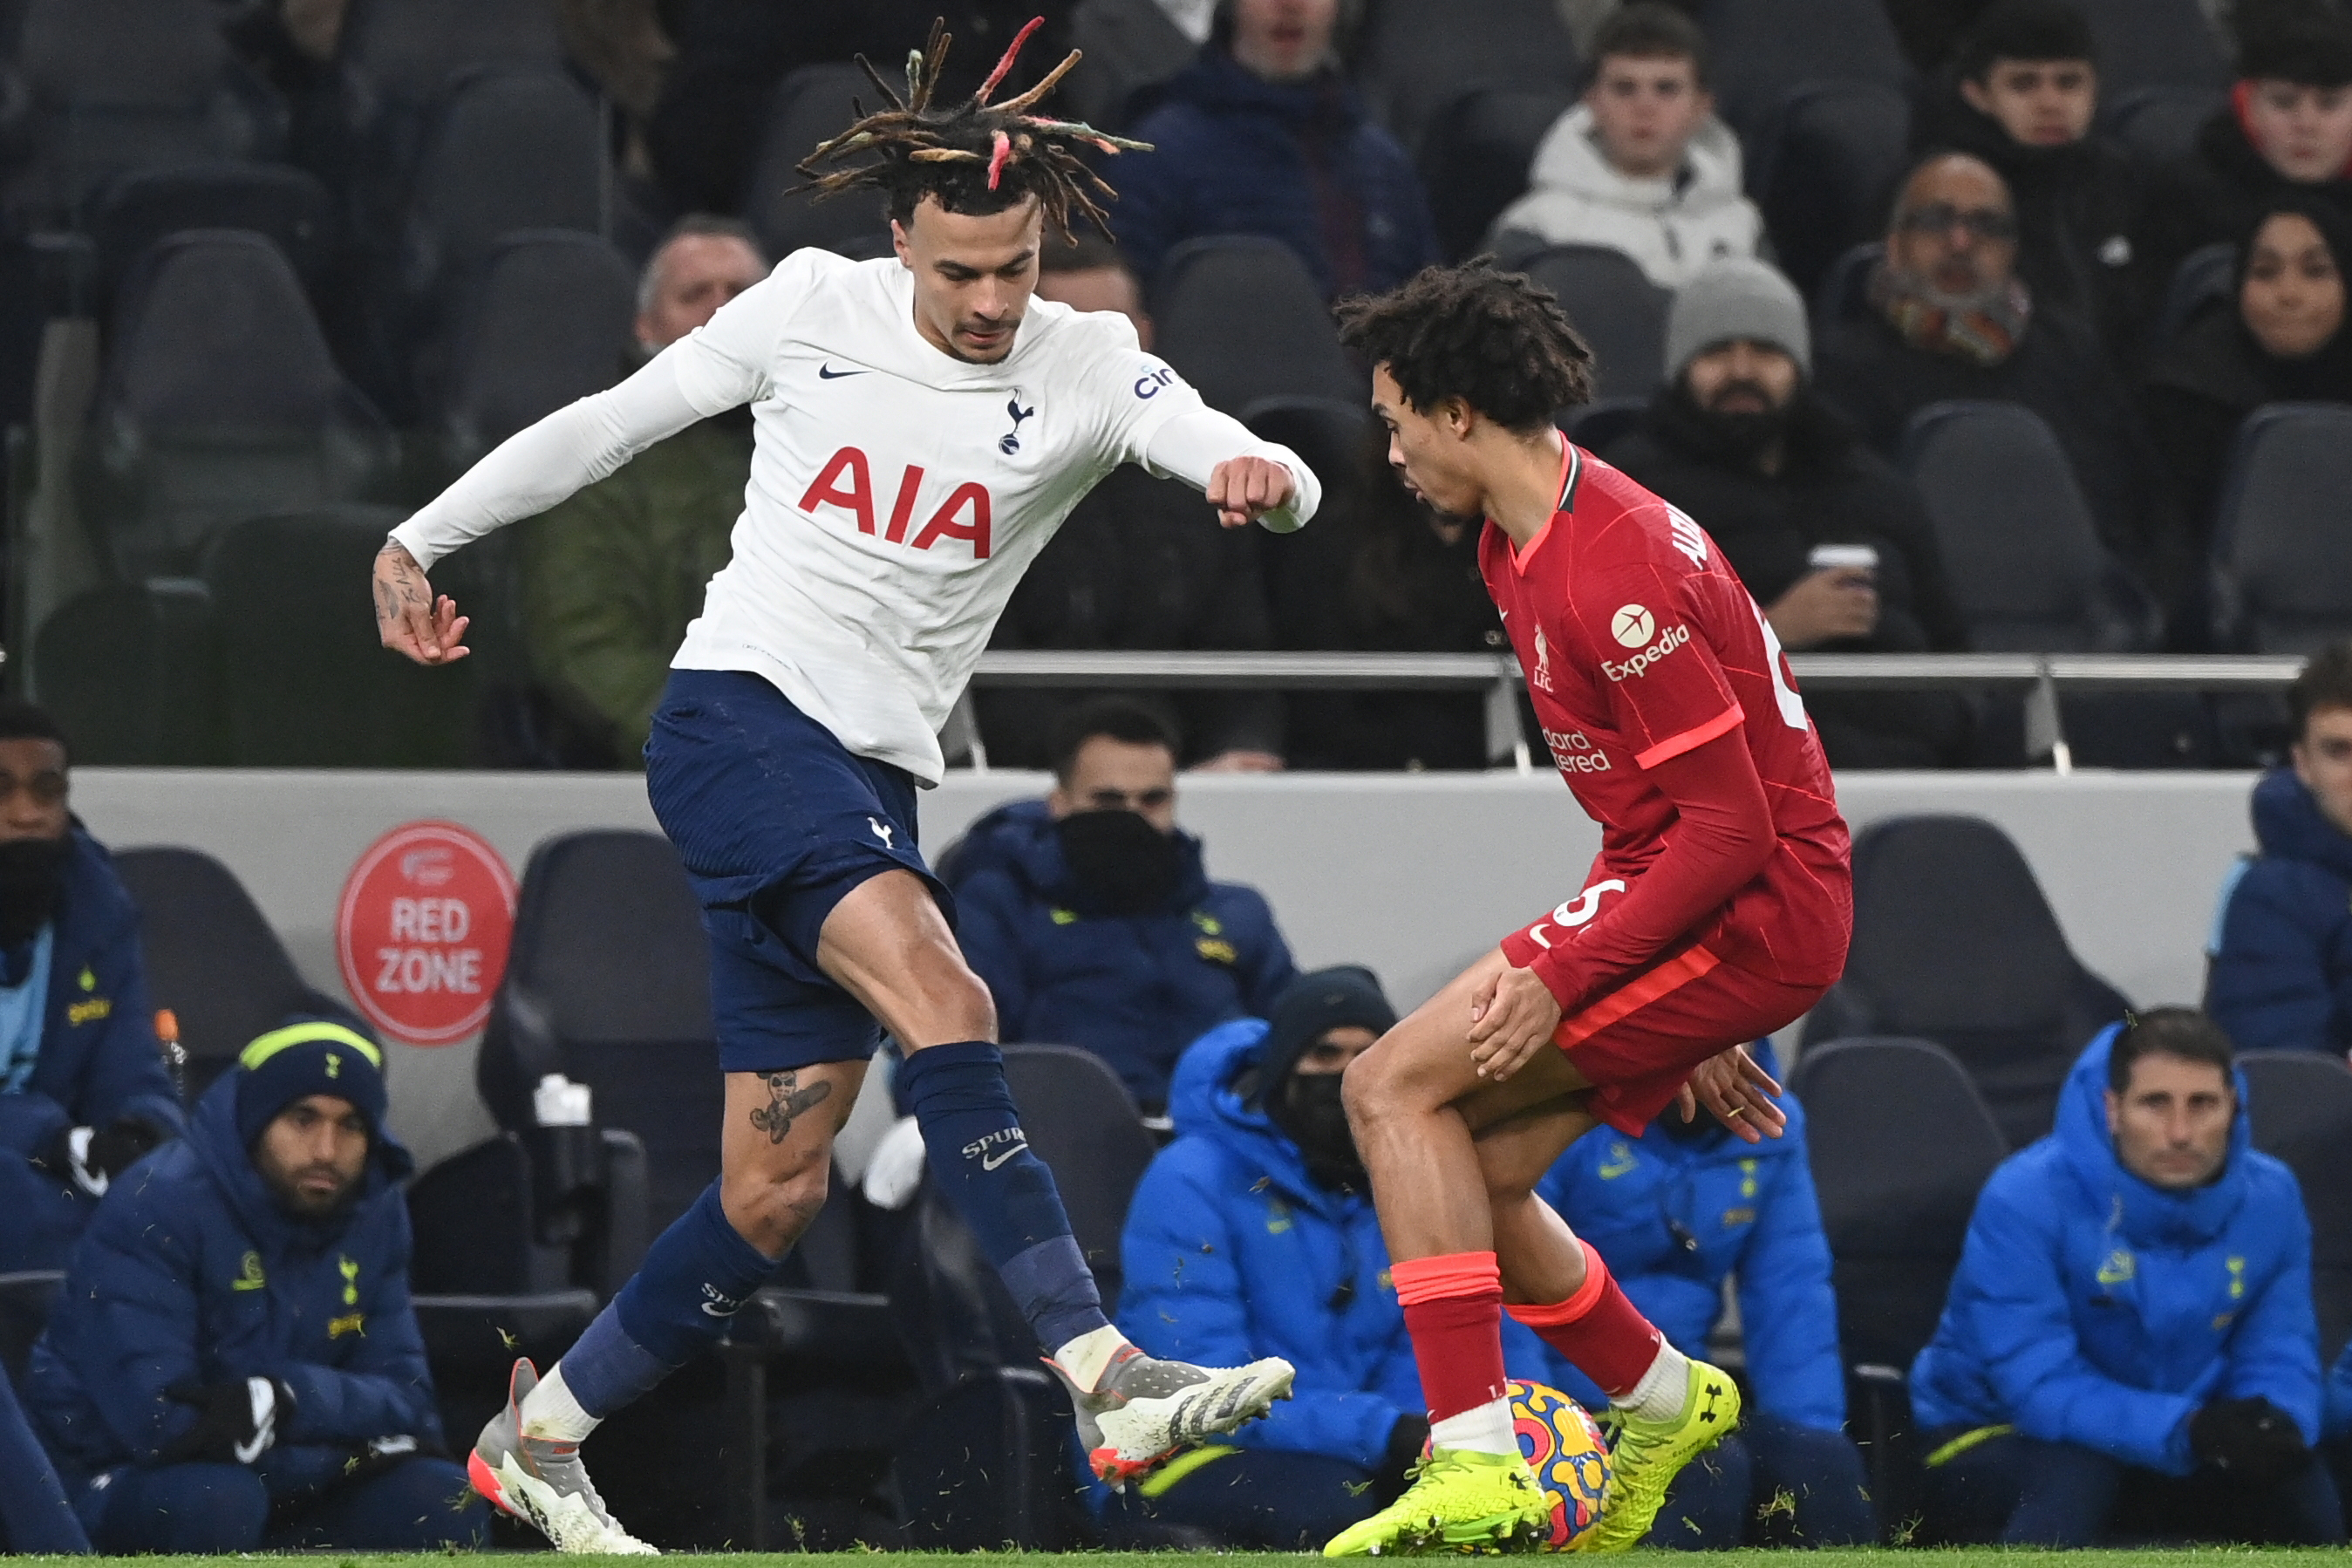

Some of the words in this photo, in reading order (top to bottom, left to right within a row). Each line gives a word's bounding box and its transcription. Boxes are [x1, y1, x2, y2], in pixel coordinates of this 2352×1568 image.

[798, 446, 991, 559] AIA
[1601, 624, 1690, 682] Expedia
[1533, 670, 1554, 692] LFC
[392, 897, 470, 943] RED
[376, 948, 481, 992] ZONE
